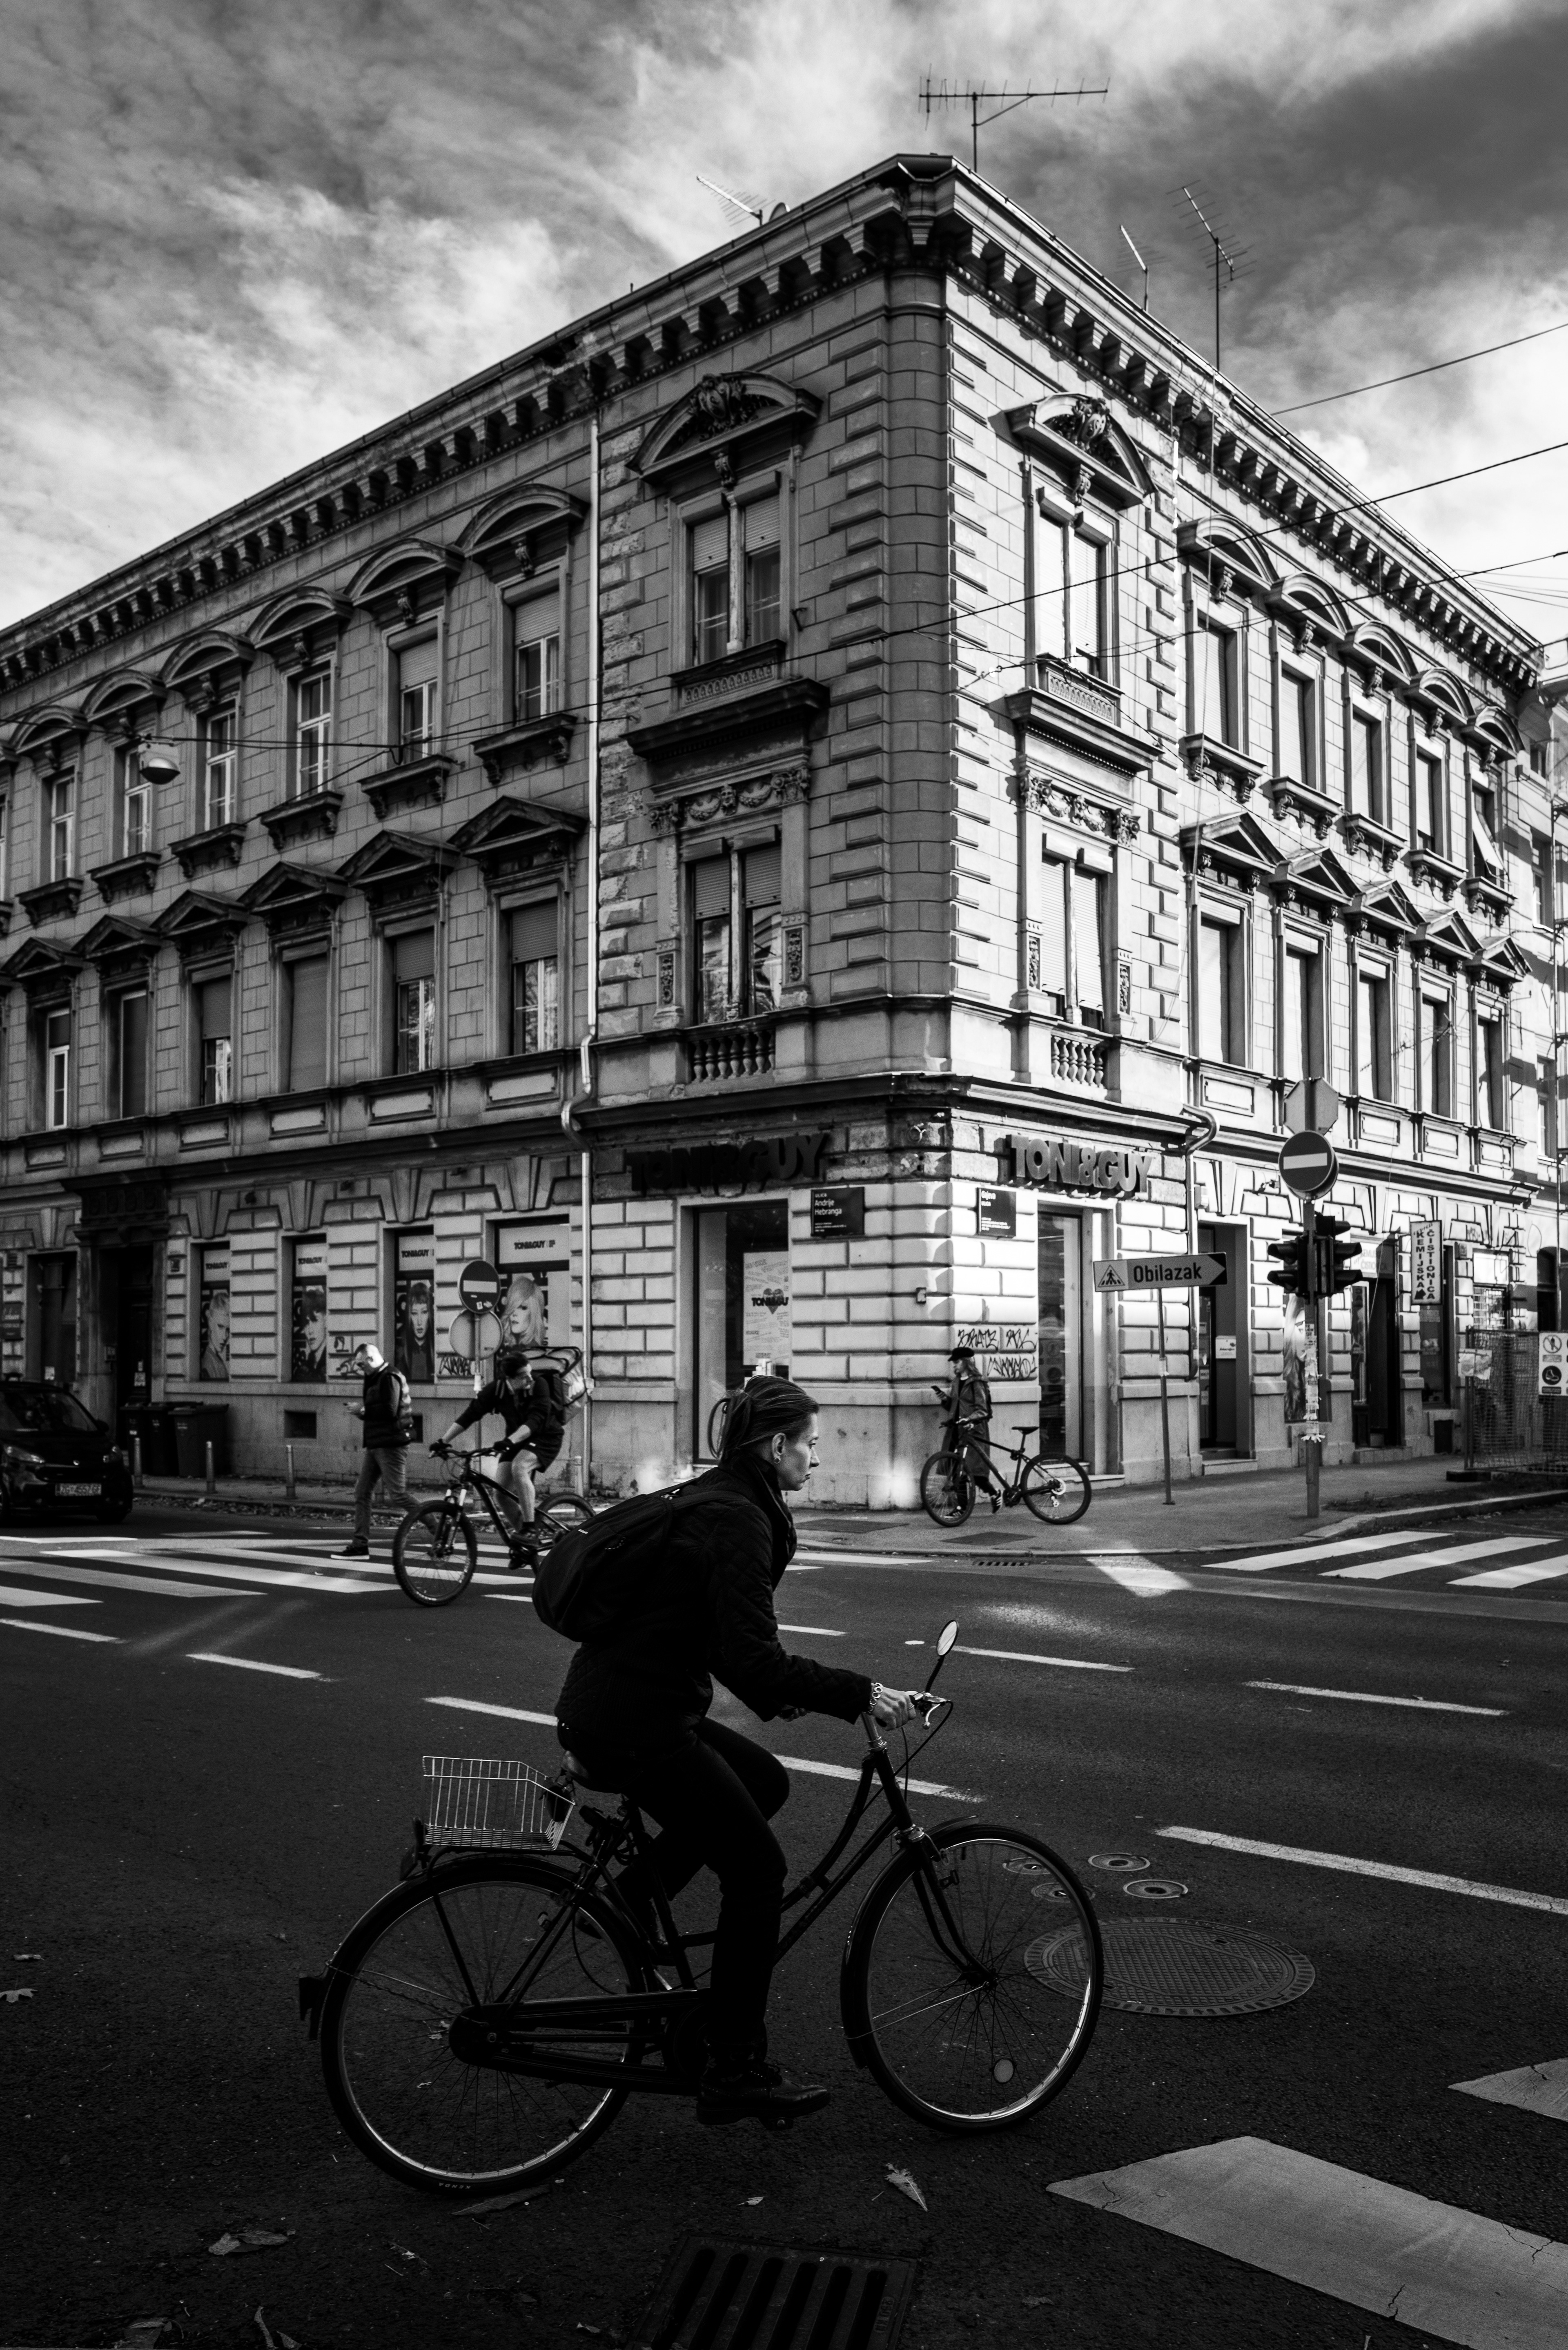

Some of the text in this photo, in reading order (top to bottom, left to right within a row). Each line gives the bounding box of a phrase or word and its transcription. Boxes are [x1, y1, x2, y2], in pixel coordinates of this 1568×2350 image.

[626, 1133, 826, 1191] TONI&GUY
[1006, 1134, 1153, 1193] TONI&GUY
[815, 1199, 835, 1207] Andrije
[815, 1208, 842, 1216] Hebranga
[514, 1240, 545, 1250] TONI&GUY
[1416, 1231, 1425, 1289] KEMIJSKA
[1426, 1229, 1436, 1300] ČISTIONICA
[1133, 1262, 1202, 1283] Obilazak
[752, 1297, 788, 1307] TONI&GU
